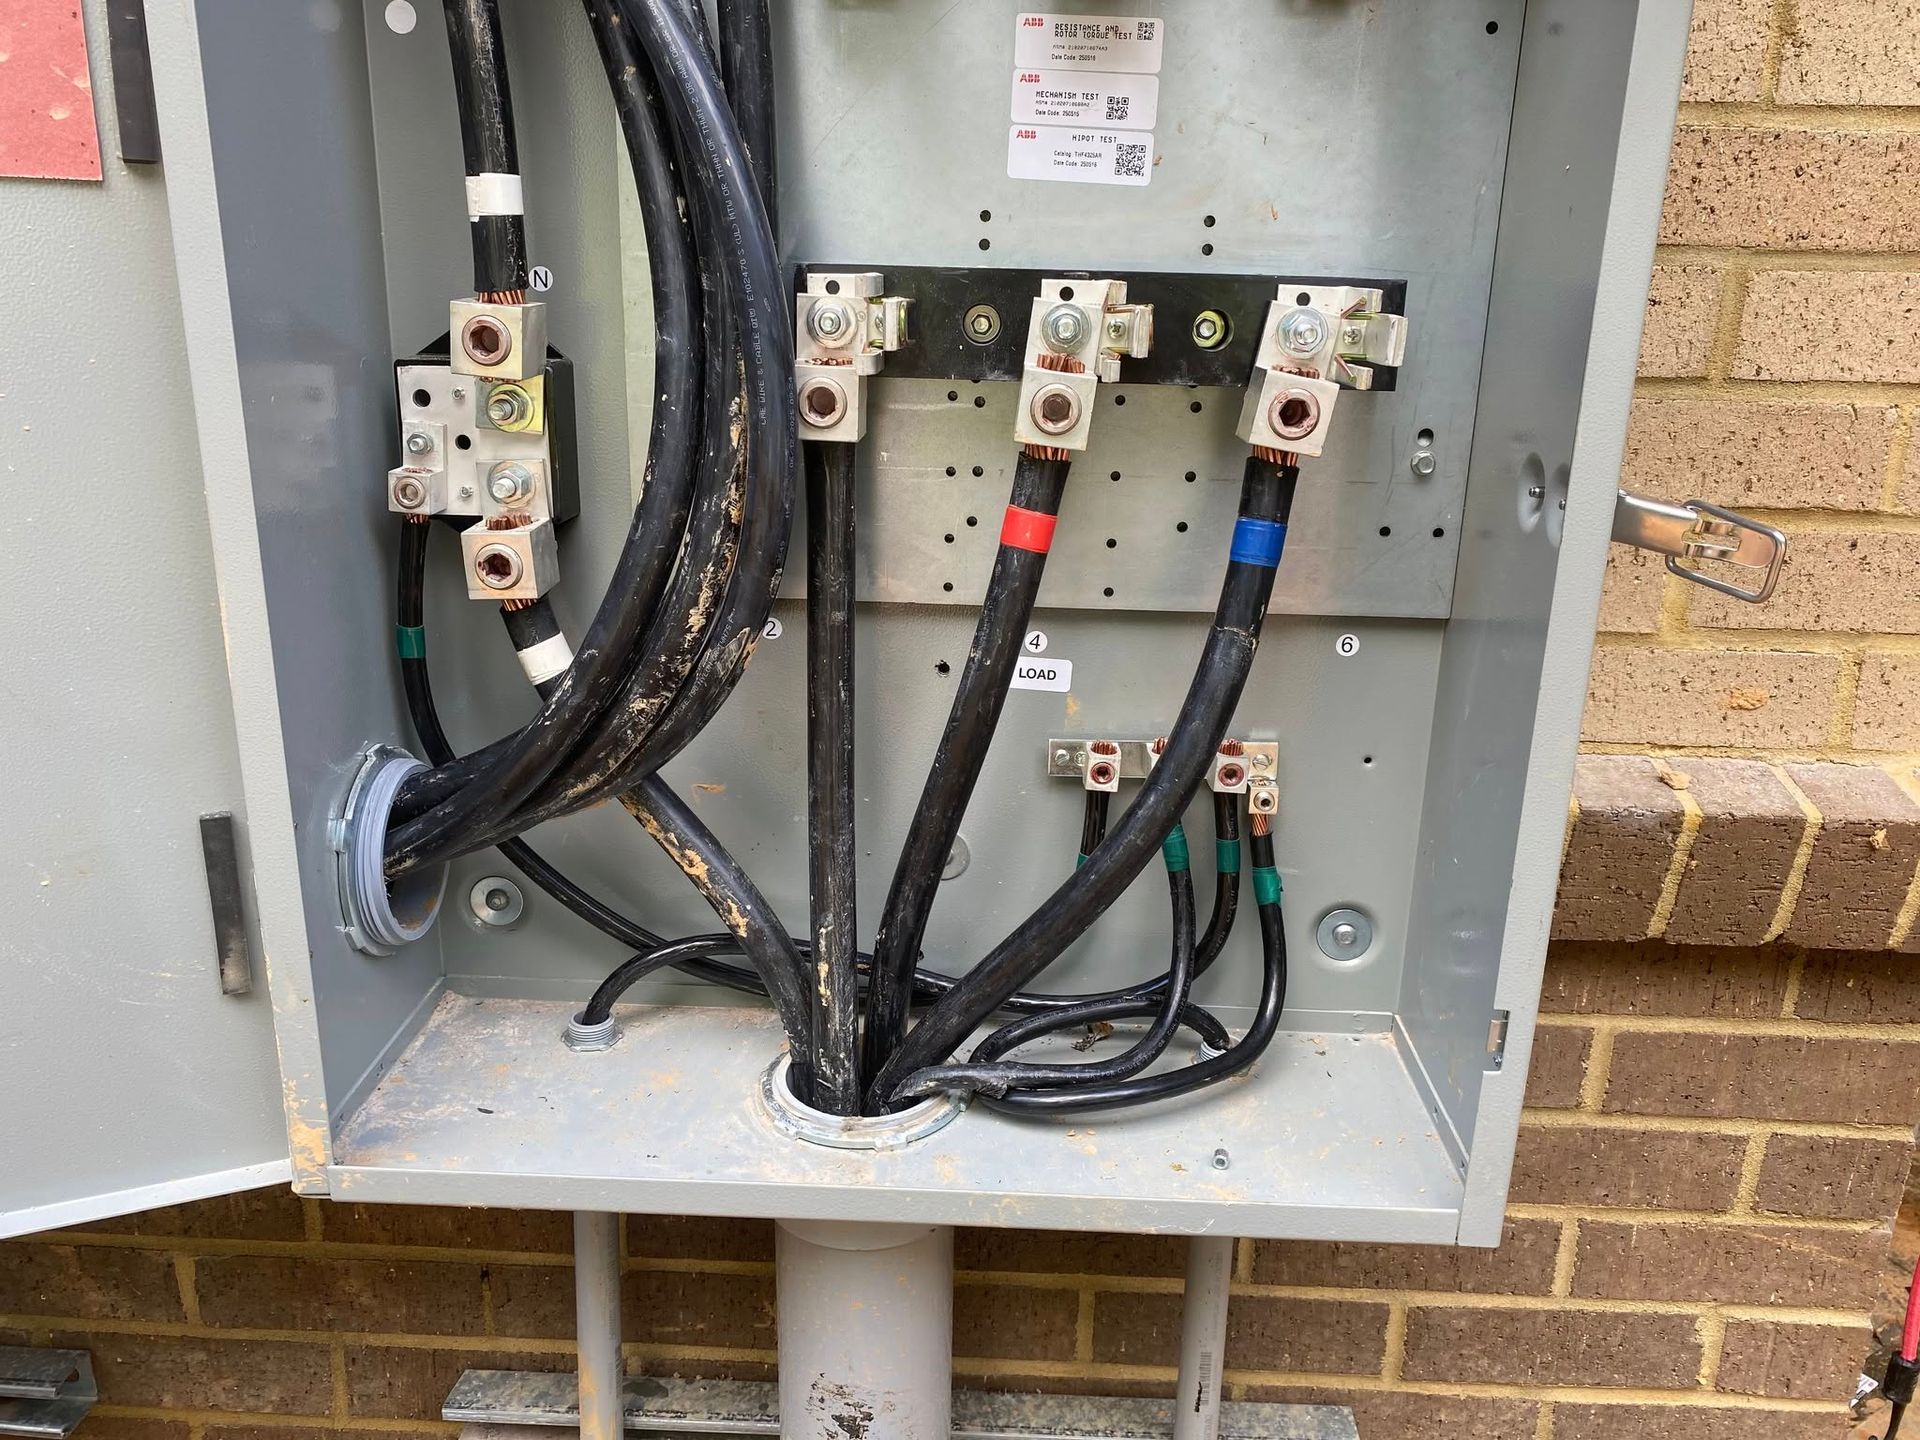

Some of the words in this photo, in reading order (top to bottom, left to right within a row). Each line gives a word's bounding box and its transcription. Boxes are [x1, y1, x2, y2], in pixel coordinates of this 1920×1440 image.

[1023, 17, 1044, 27] ABB
[1054, 23, 1101, 32] RESISTANCE
[1054, 30, 1078, 38] ROTOR
[1083, 31, 1109, 40] TORQUE
[1114, 32, 1133, 40] TEST
[675, 60, 689, 79] AWM
[1019, 73, 1041, 83] ABB
[685, 81, 695, 95] OR
[1035, 90, 1077, 99] MECHANISM
[1082, 92, 1100, 101] TEST
[1016, 129, 1037, 139] ABB
[1072, 134, 1095, 142] HIPOT
[706, 138, 716, 151] OR
[711, 153, 725, 179] THHN
[720, 182, 730, 196] OR
[725, 199, 736, 220] MTW
[533, 270, 548, 288] N
[751, 332, 763, 364] CABLE
[765, 621, 777, 637] 2
[1029, 634, 1041, 649] 4
[1341, 636, 1353, 653] 6
[1019, 667, 1057, 681] LOAD
